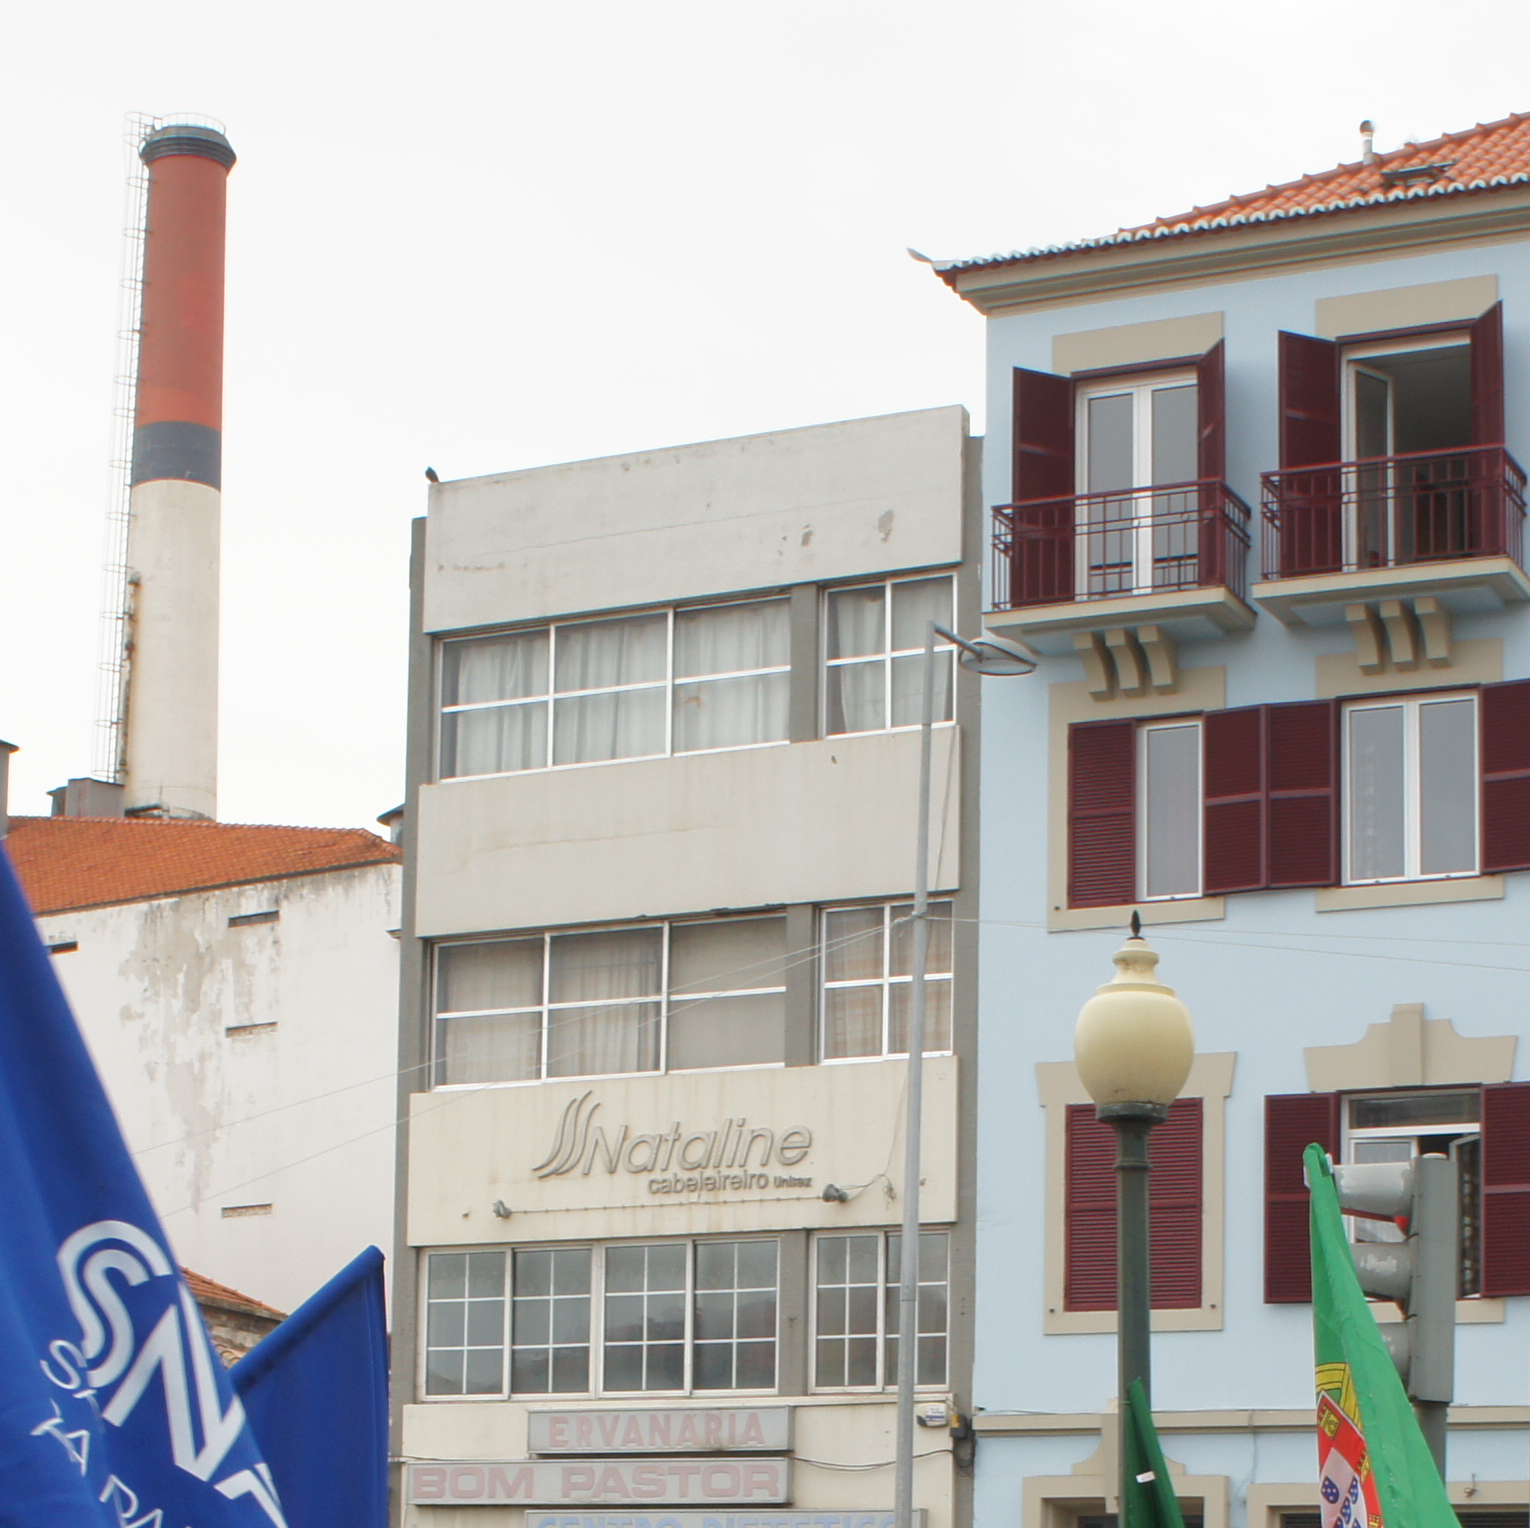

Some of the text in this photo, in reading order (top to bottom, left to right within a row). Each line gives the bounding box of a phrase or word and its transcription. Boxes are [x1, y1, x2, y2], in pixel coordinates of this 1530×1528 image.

[582, 1117, 813, 1177] Nataline
[647, 1169, 769, 1194] cabeleireiro
[412, 1464, 780, 1500] BOM PASTOR
